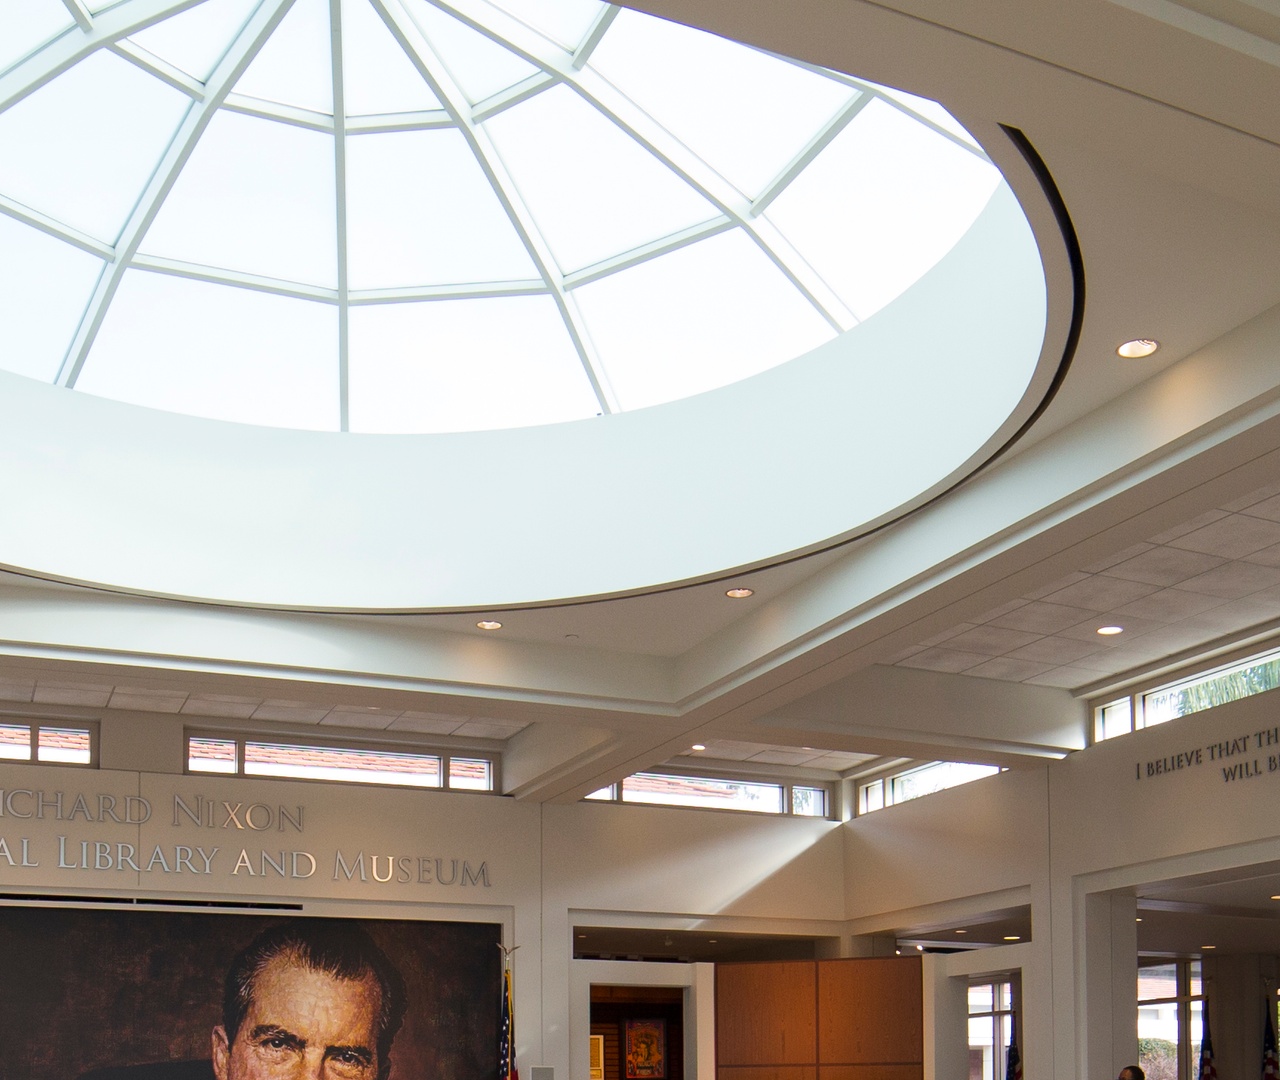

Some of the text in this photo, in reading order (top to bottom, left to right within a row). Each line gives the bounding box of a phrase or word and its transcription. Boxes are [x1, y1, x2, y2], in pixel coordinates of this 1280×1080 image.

[1134, 761, 1142, 781] I
[1146, 748, 1203, 777] BELIEVE
[1206, 734, 1250, 761] THAT
[1221, 761, 1263, 783] WILL
[171, 794, 305, 833] NIXON
[57, 836, 221, 875] LIBRARY
[230, 848, 318, 879] AND
[332, 849, 493, 888] MUSEUM
